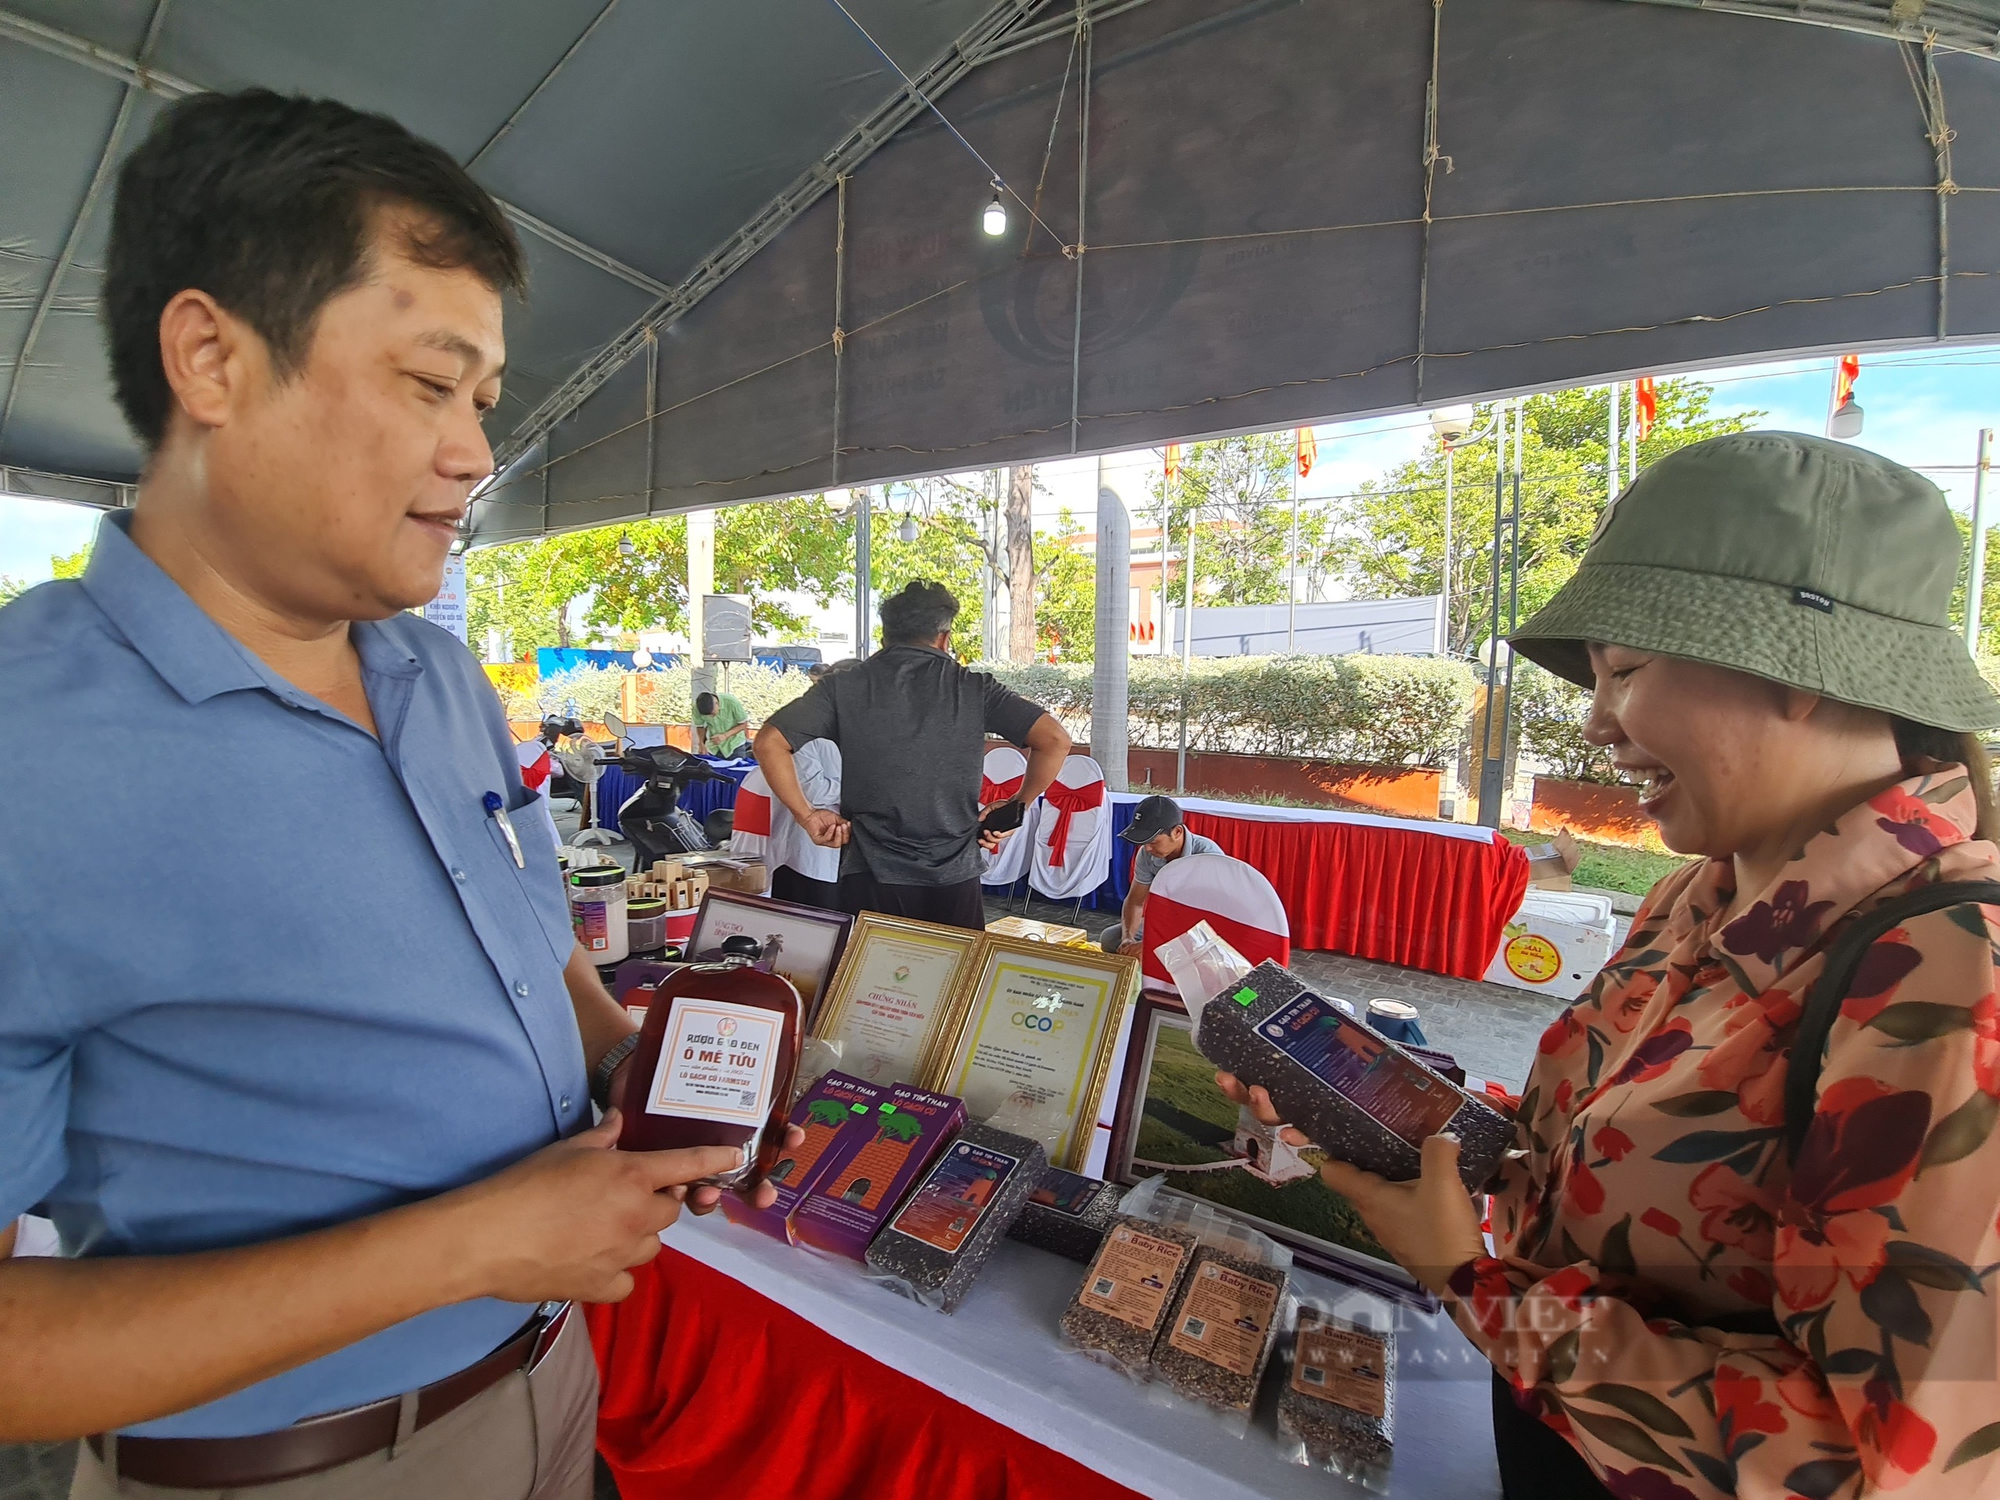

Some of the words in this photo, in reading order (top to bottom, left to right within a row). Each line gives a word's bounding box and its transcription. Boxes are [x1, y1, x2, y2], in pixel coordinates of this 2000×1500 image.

[1011, 1012, 1065, 1034] OCOP
[717, 1037, 738, 1048] GO
[740, 1041, 760, 1051] ĐEN
[683, 1046, 694, 1060] Ô
[699, 1049, 723, 1064] MÊ
[728, 1051, 757, 1068] TỬU
[826, 1078, 842, 1087] GẠO
[843, 1082, 856, 1090] TIM
[856, 1086, 878, 1097] THAN
[894, 1089, 911, 1098] GẠO
[926, 1097, 949, 1109] THAN
[1130, 1237, 1156, 1251] Baby
[1157, 1246, 1179, 1258] Rice
[1220, 1273, 1247, 1290] Baby
[1248, 1284, 1273, 1299] Rice
[1324, 1327, 1353, 1343] Baby
[1357, 1339, 1382, 1351] Rice
